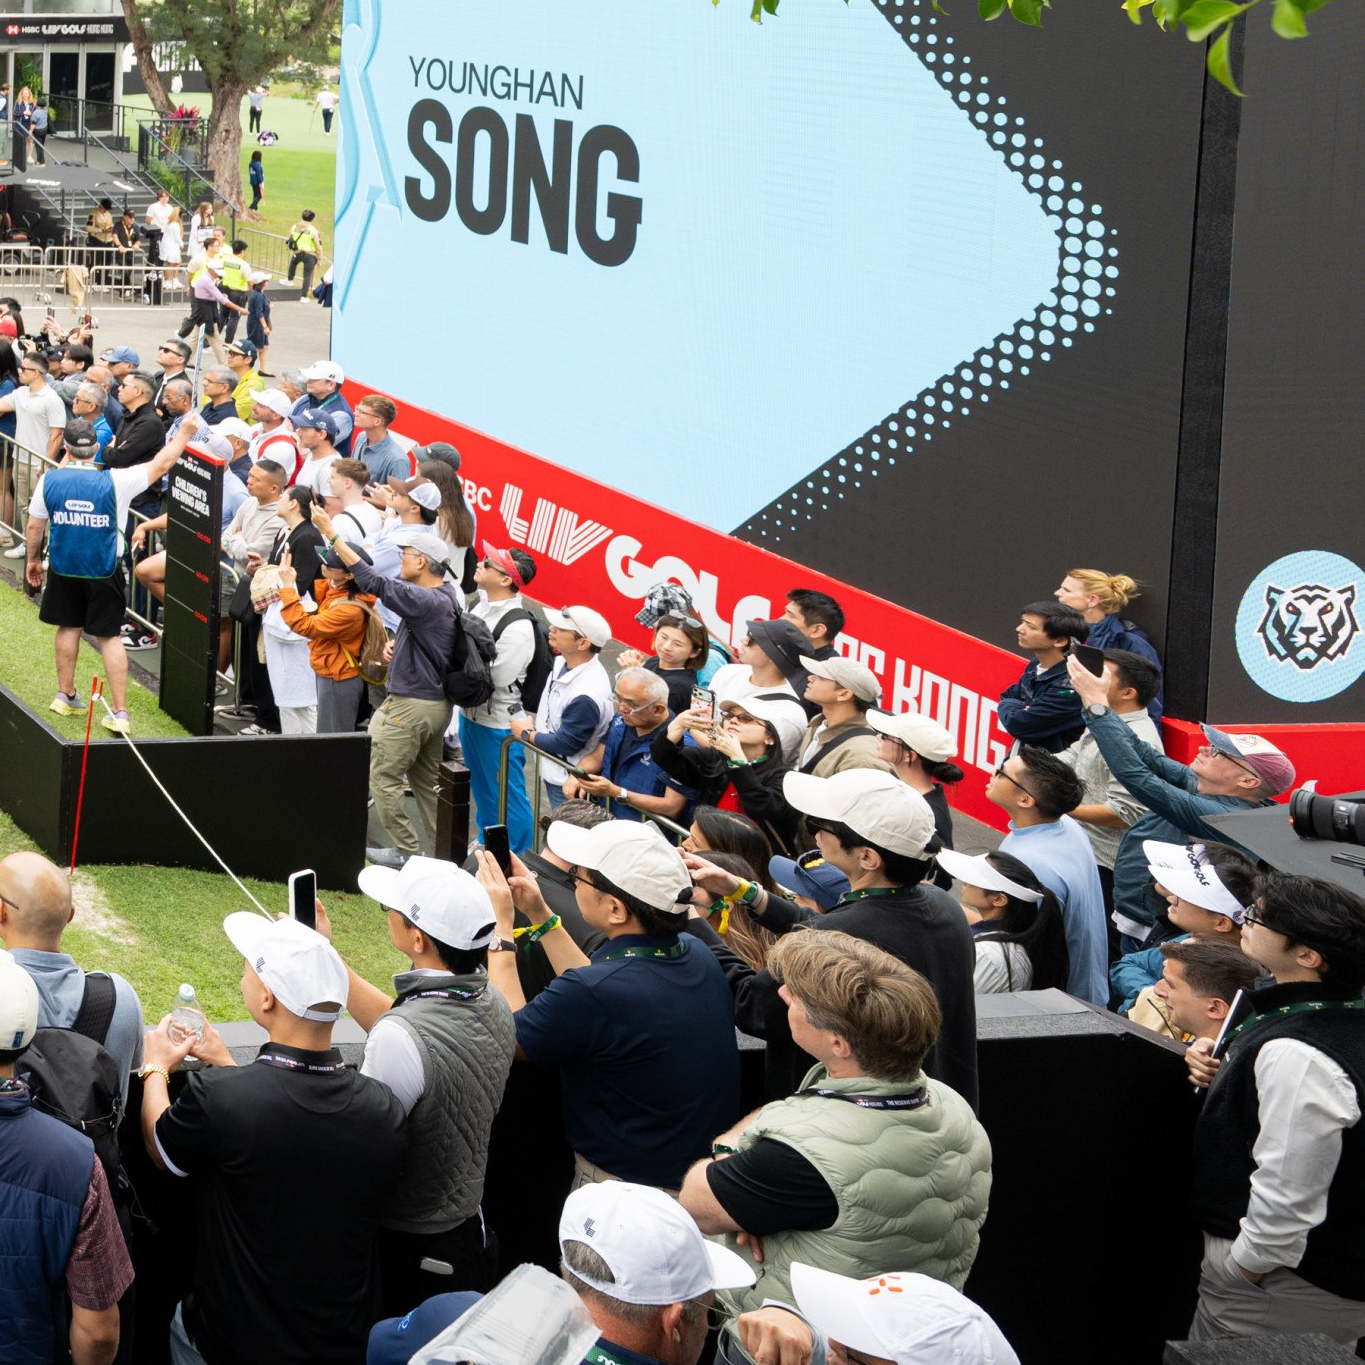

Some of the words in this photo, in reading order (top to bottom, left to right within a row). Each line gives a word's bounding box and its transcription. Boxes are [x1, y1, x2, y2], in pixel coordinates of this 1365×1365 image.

[21, 26, 40, 34] HSBC
[408, 55, 585, 110] YOUNGHAN
[404, 99, 644, 267] SONG
[175, 475, 207, 503] CHILDREN'S
[53, 511, 110, 528] VOLUNTEER
[458, 475, 492, 512] BC
[499, 482, 614, 566] LIV
